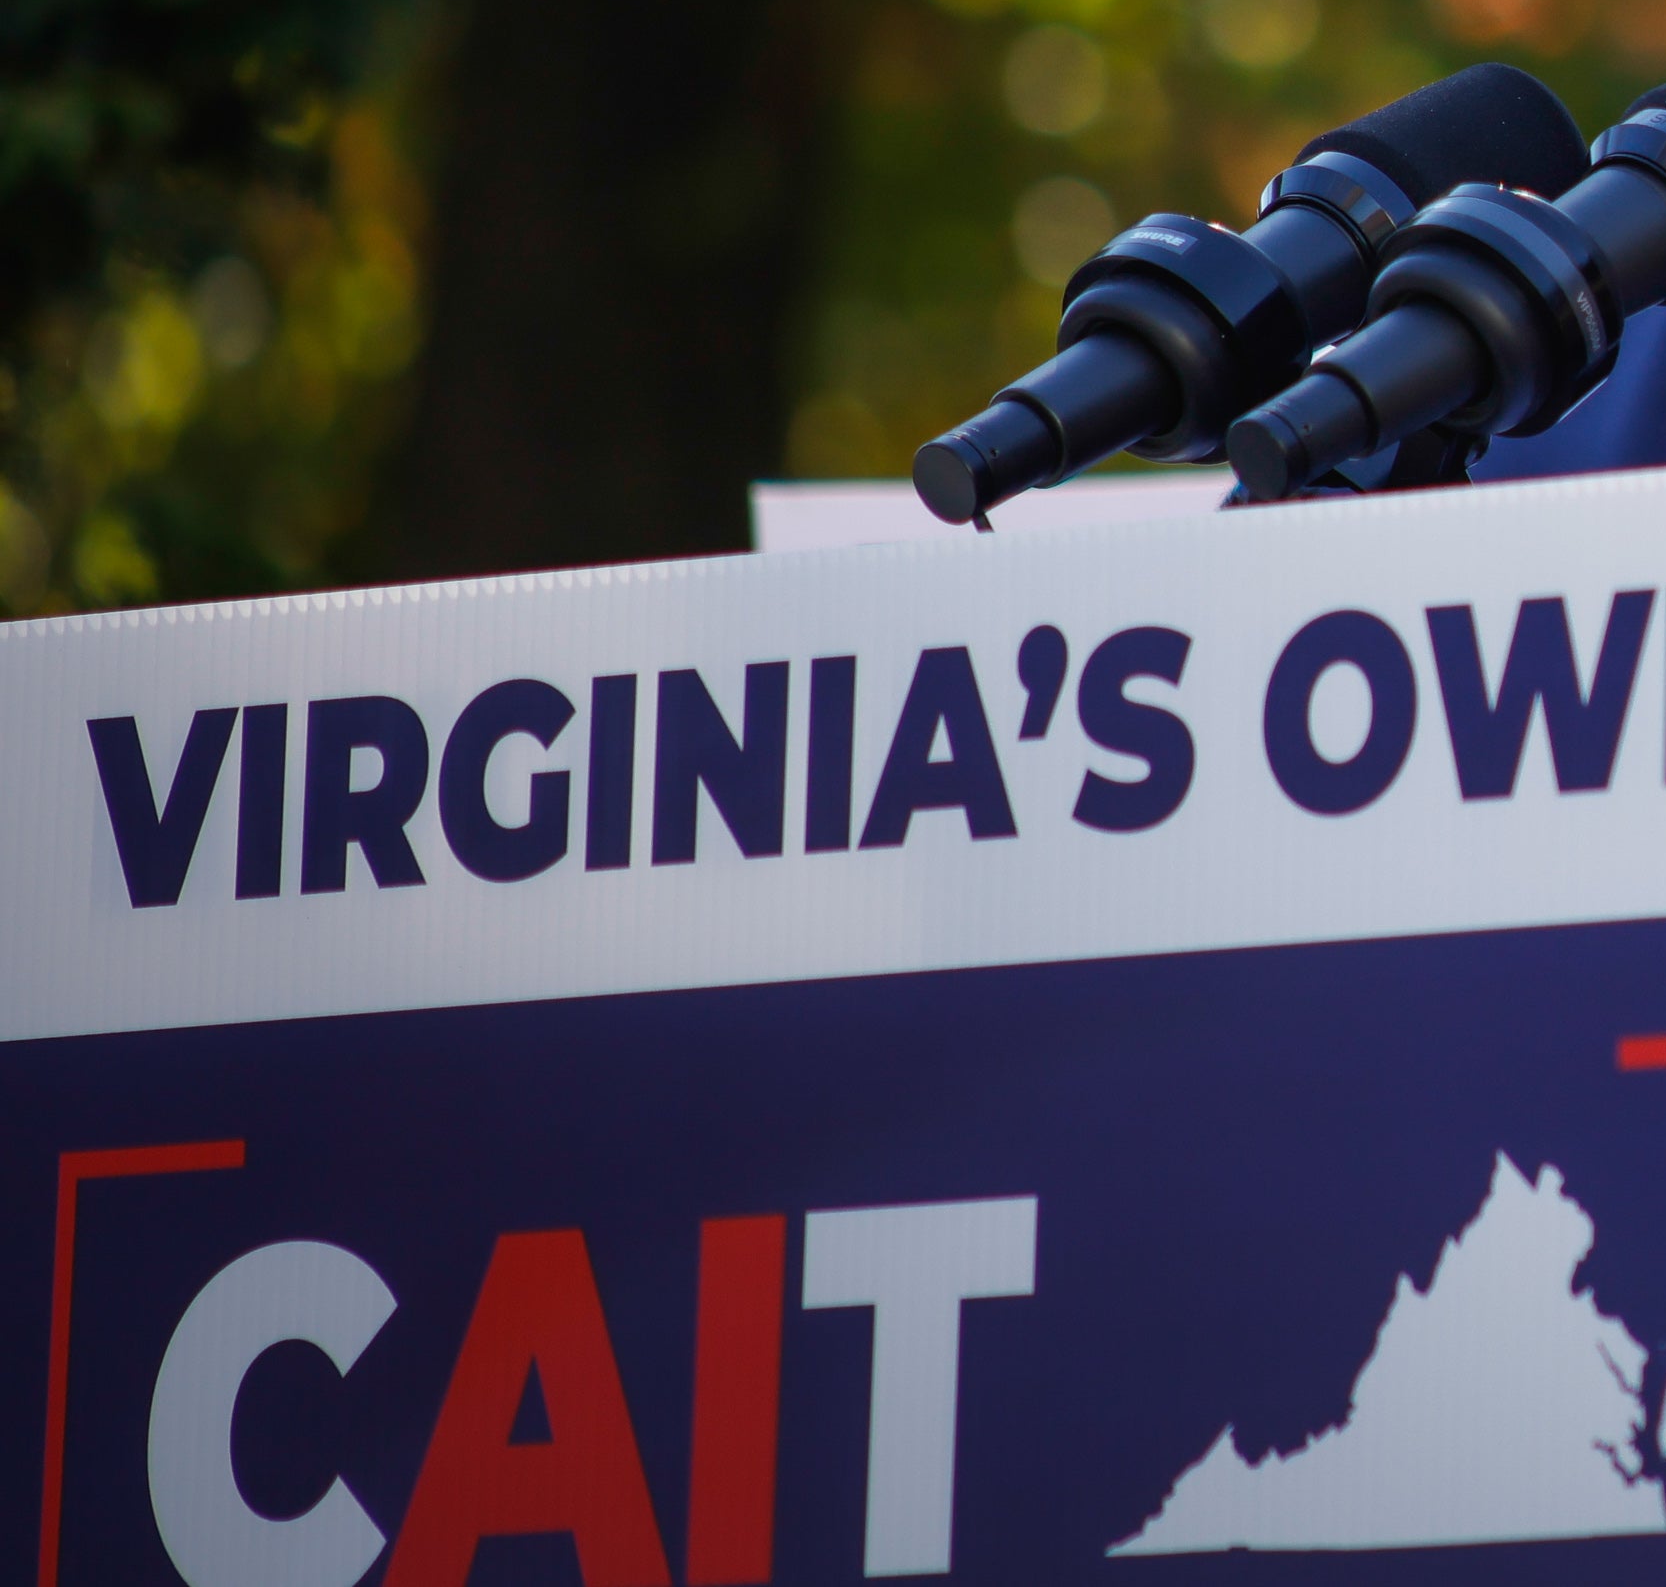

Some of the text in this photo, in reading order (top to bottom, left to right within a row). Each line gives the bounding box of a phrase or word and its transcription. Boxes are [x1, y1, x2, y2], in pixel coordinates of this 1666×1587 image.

[1129, 231, 1186, 247] SHURE
[86, 624, 1196, 910] VIRGINIA'S
[147, 1195, 1038, 1587] CAIT
